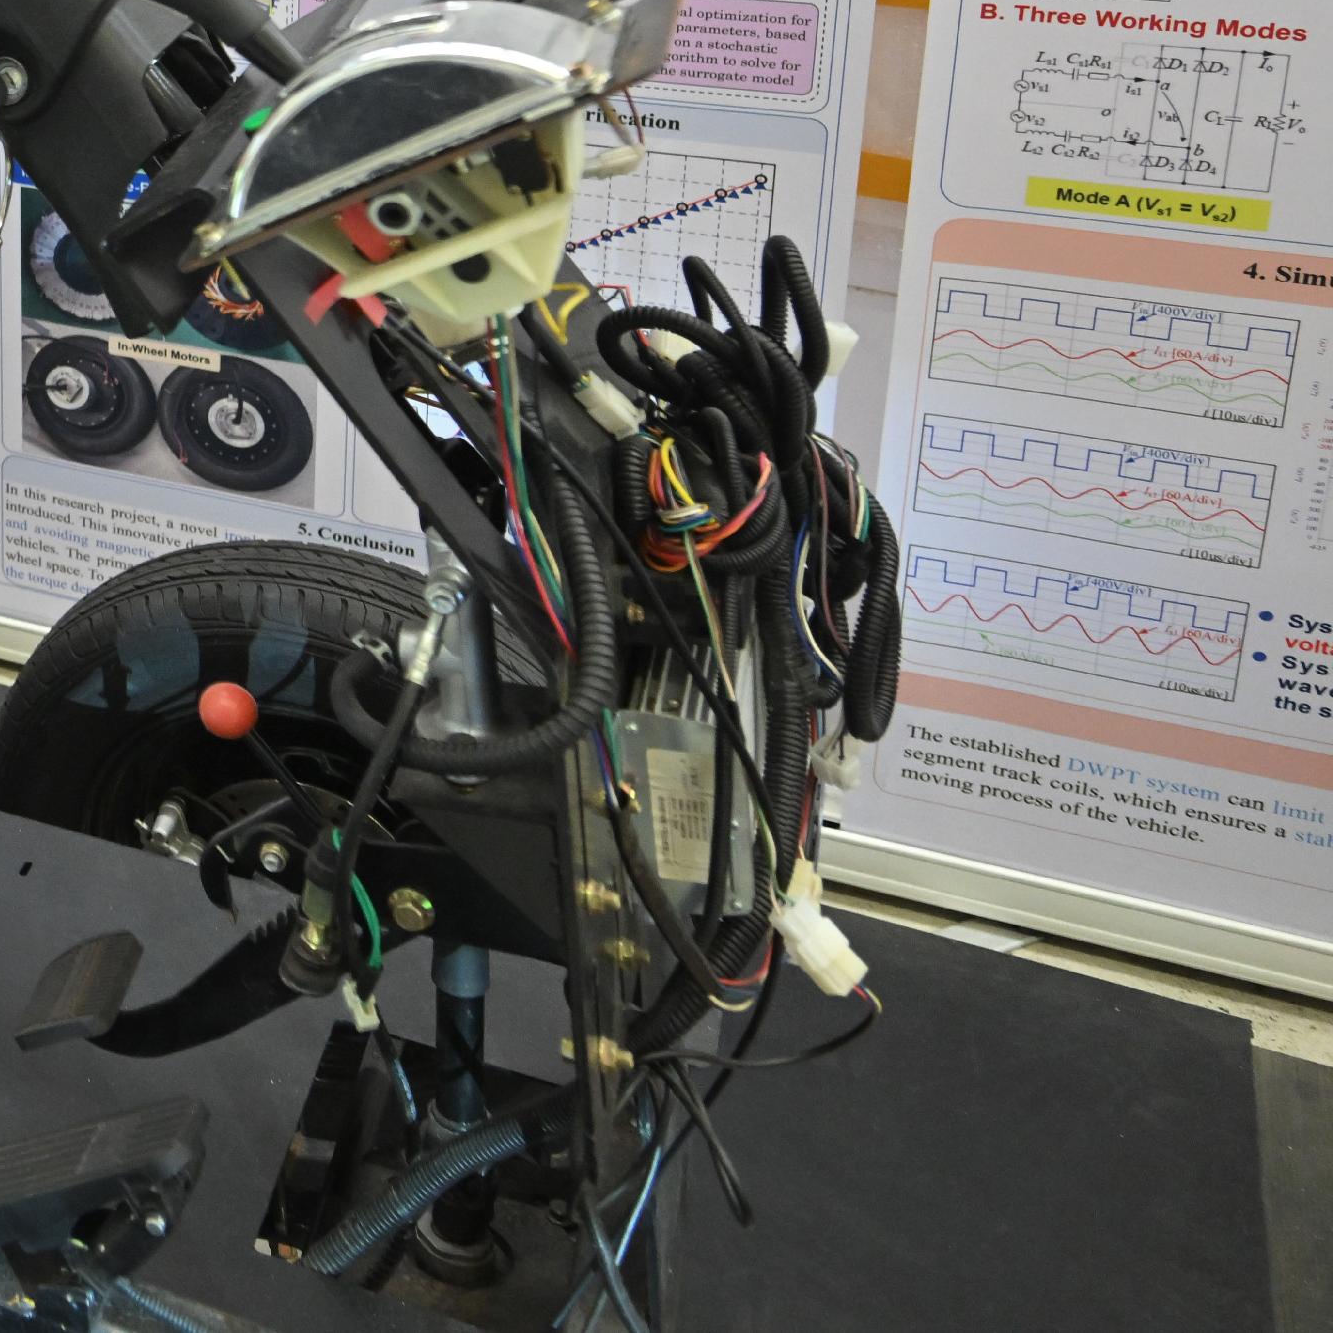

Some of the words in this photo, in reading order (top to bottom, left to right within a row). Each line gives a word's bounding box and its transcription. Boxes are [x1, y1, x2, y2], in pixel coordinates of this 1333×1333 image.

[980, 2, 1004, 21] B.
[1014, 4, 1087, 26] Three
[1095, 9, 1207, 39] Working
[1216, 18, 1307, 42] Modes
[1242, 262, 1266, 281] 4.
[117, 341, 167, 358] In-Wheel
[170, 349, 211, 365] Motors
[298, 522, 312, 537] 5.
[317, 527, 415, 558] Conclusion
